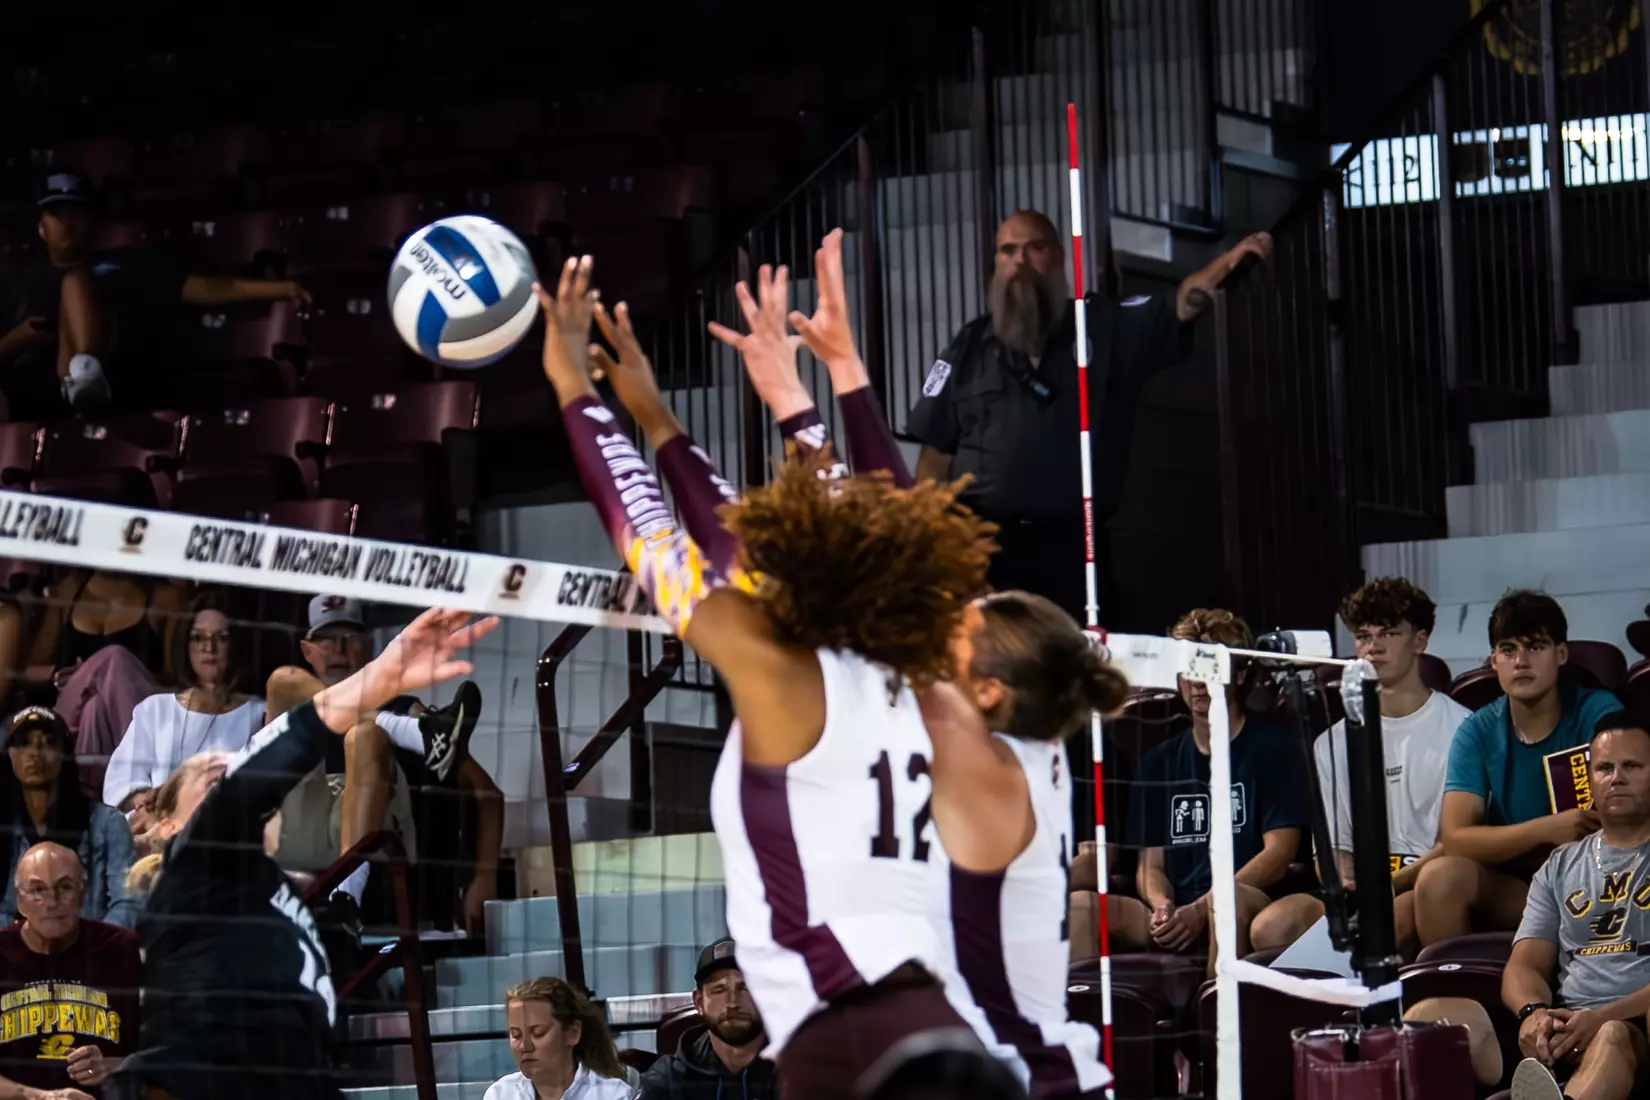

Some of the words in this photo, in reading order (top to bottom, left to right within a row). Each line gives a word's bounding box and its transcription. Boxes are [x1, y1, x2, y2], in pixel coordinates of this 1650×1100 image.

[409, 243, 467, 301] molten
[0, 501, 83, 546] LEYBALL
[185, 524, 266, 569] CENTRAL
[272, 535, 363, 579] MICHIGAN
[363, 545, 469, 593] VOLLEYBALL
[558, 571, 631, 612] CENTRAL
[868, 750, 933, 862] 12
[1580, 941, 1632, 955] CHIPPEWAS
[0, 1002, 120, 1043] HIPPEWAS
